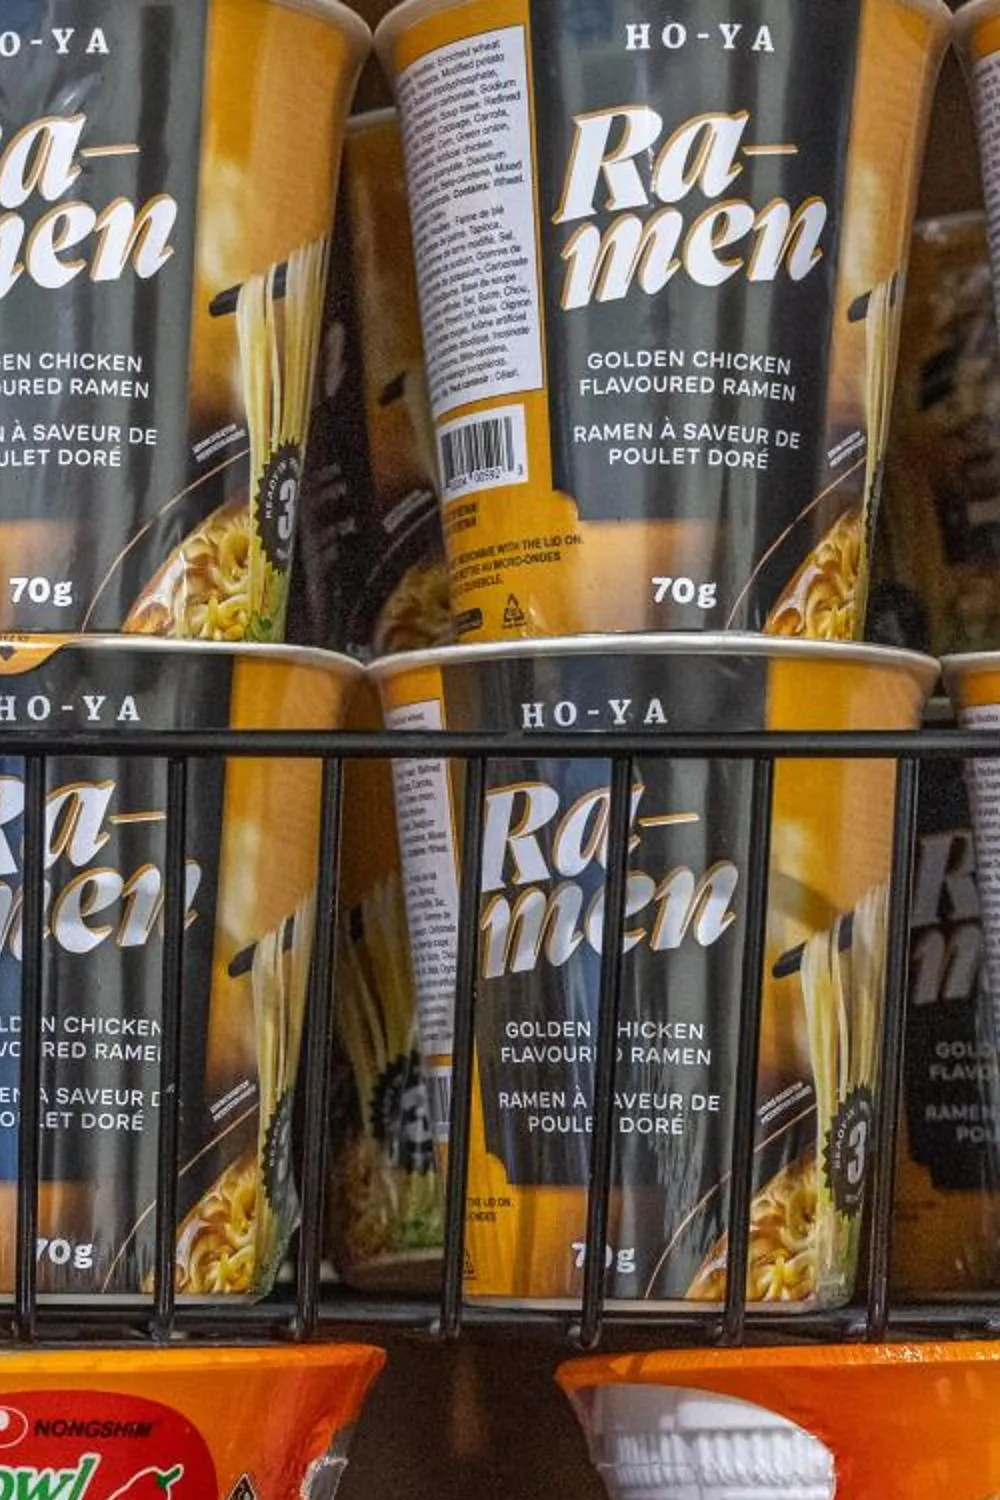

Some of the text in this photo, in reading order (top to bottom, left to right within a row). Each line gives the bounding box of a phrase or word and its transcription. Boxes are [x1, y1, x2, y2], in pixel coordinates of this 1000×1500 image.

[626, 24, 774, 52] HO-YA
[561, 196, 827, 312] men
[39, 352, 142, 373] CHICKEN
[588, 351, 790, 374] GOLDEN CHICKEN
[69, 378, 149, 399] RAMEN
[579, 376, 795, 401] FLAVOURED RAMEN
[11, 419, 28, 442] À
[32, 423, 121, 443] SAVEUR
[128, 427, 157, 445] DE
[574, 417, 800, 449] RAMEN À SAVEUR DE
[57, 446, 121, 467] DORÉ
[609, 449, 769, 469] POULET DORÉ
[523, 538, 542, 550] THE
[521, 698, 668, 729] HO-YA
[506, 1021, 704, 1041] GOLDEN HICKEN
[631, 1047, 712, 1065] RAMEN
[56, 1088, 143, 1107] SAVEUR
[500, 1085, 720, 1112] RAMEN À AVEUR DE
[81, 1110, 144, 1131] DORÉ
[528, 1113, 684, 1135] POULE DORÉ
[34, 1419, 153, 1439] NONGSHIM
